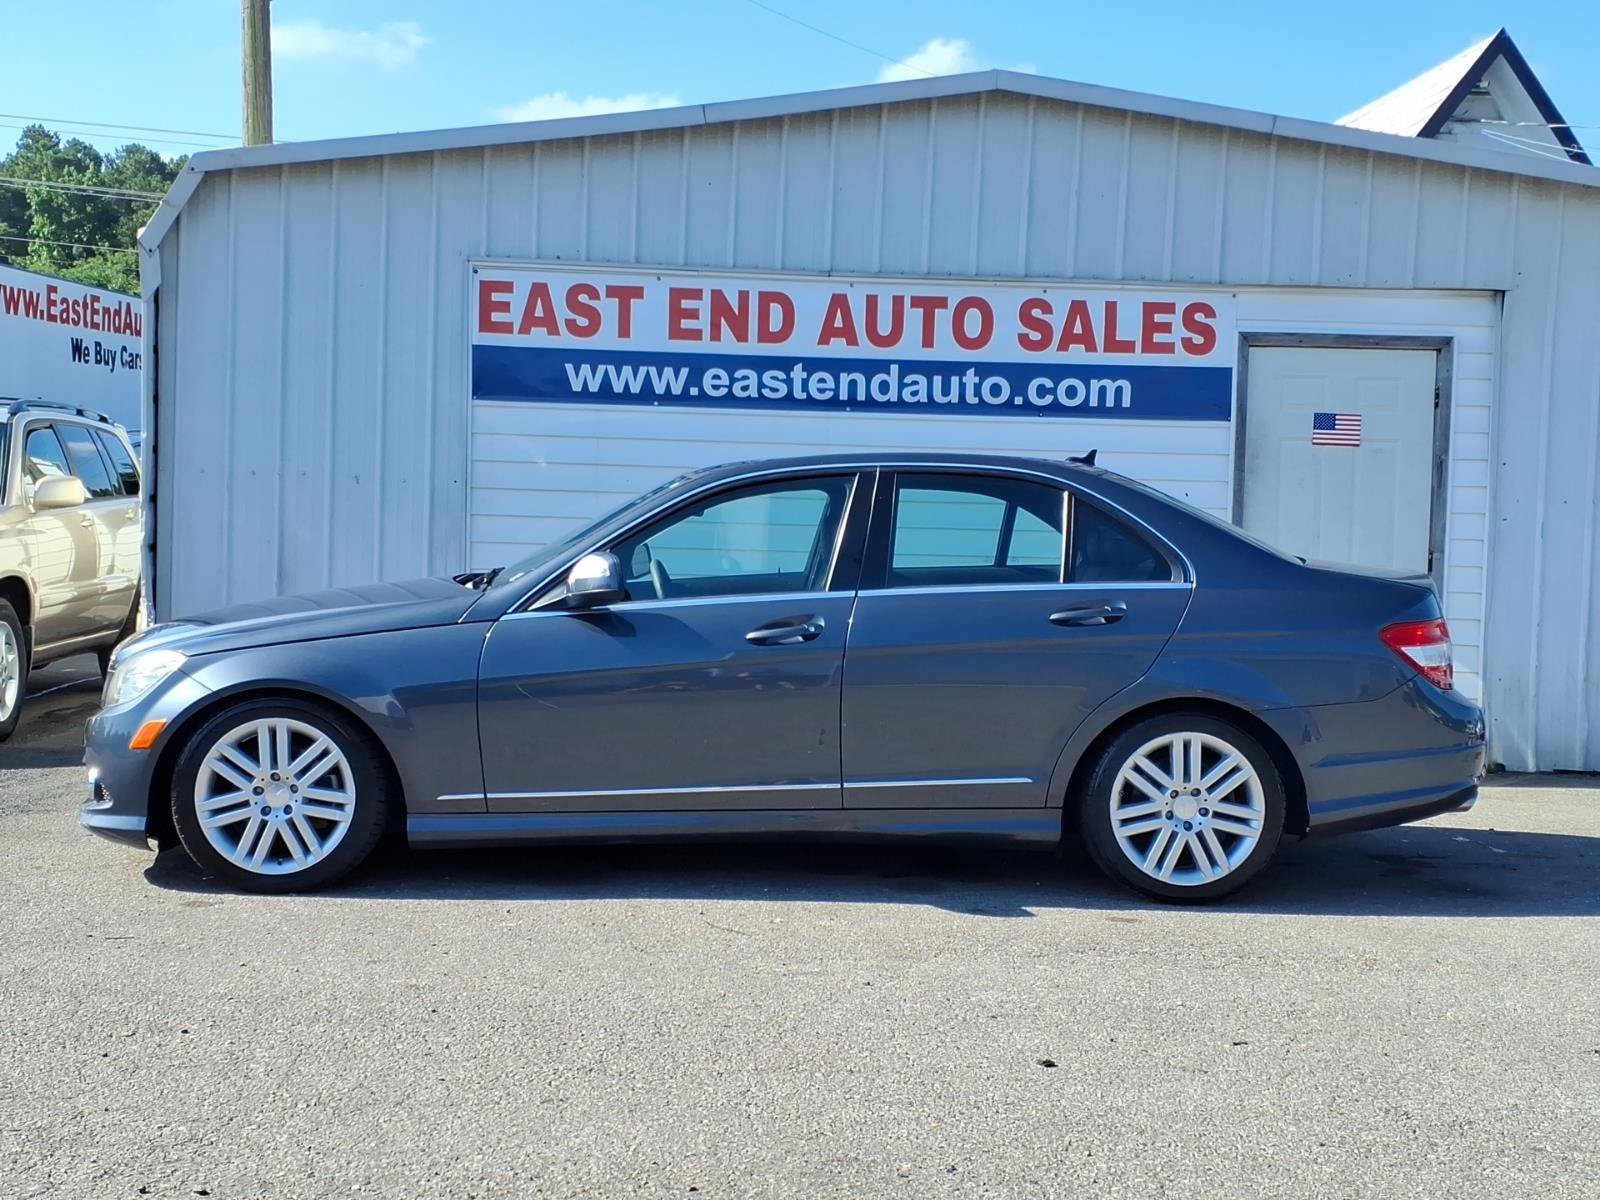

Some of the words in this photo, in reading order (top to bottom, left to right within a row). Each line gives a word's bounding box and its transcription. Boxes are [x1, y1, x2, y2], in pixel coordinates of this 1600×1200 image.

[0, 284, 142, 337] ww.EastEndAu
[478, 279, 645, 339] EAST
[668, 287, 796, 345] END
[816, 292, 995, 351] AUTO
[1016, 297, 1217, 356] SALES
[70, 337, 90, 364] We
[94, 341, 117, 373] Buy
[564, 361, 1132, 408] www.eastendauto.com
